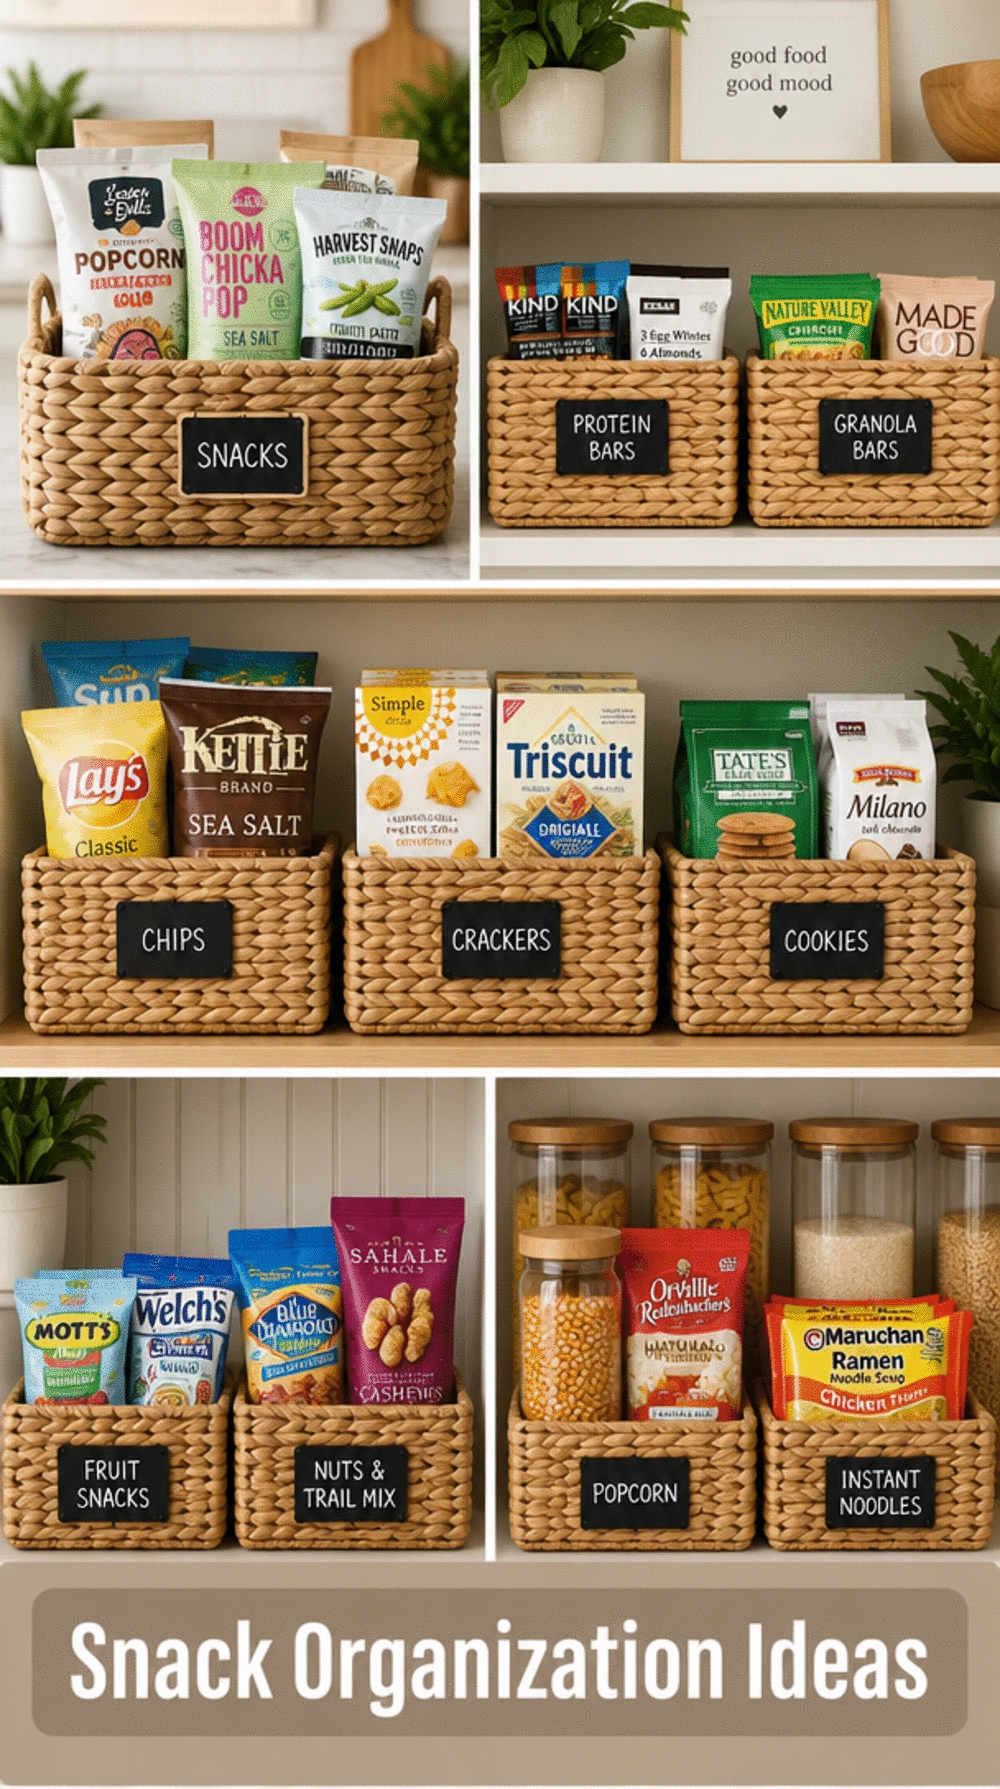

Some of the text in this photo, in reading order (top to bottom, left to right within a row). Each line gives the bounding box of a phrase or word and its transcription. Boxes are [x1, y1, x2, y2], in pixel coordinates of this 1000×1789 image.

[730, 45, 827, 69] good food
[726, 73, 832, 97] good mood
[199, 220, 264, 252] BOOM
[313, 232, 378, 258] HARVEST
[379, 233, 425, 267] SNAPS
[74, 248, 187, 275] POPCORN
[201, 253, 284, 284] CHICKA
[202, 284, 248, 319] POP
[507, 295, 559, 316] KIND
[567, 295, 618, 314] KIND
[765, 301, 869, 325] NATURE VALLEY
[895, 302, 976, 330] MADE
[223, 329, 280, 347] SEA SALT
[896, 328, 974, 357] GOOD
[649, 347, 703, 359] Almonds
[573, 413, 652, 434] PROTEIN
[834, 413, 917, 434] GRANOLA
[197, 441, 289, 469] SNACKS
[589, 441, 636, 461] BARS
[853, 440, 899, 460] BARS
[371, 695, 425, 716] Simple
[506, 741, 633, 779] Triscuit
[716, 752, 787, 771] TATE'S
[66, 752, 143, 808] Lay's
[219, 781, 274, 794] BRAND
[846, 793, 927, 820] Milano
[188, 813, 302, 837] SEA SALT
[75, 835, 139, 859] Classic
[141, 928, 206, 952] CHIPS
[451, 928, 552, 952] CRACKERS
[784, 928, 870, 953] COOKIES
[350, 1247, 448, 1264] SAHALE
[136, 1290, 228, 1328] Welch's
[825, 1327, 924, 1346] Maruchan
[832, 1351, 904, 1370] Ramen
[820, 1388, 887, 1412] Chicken
[84, 1459, 141, 1481] FRUIT
[314, 1460, 386, 1481] NUTS &
[842, 1469, 922, 1489] INSTANT
[77, 1487, 150, 1509] SNACKS
[304, 1487, 397, 1509] TRAIL MIX
[592, 1482, 679, 1504] POPCORN
[839, 1495, 923, 1516] NOODLES
